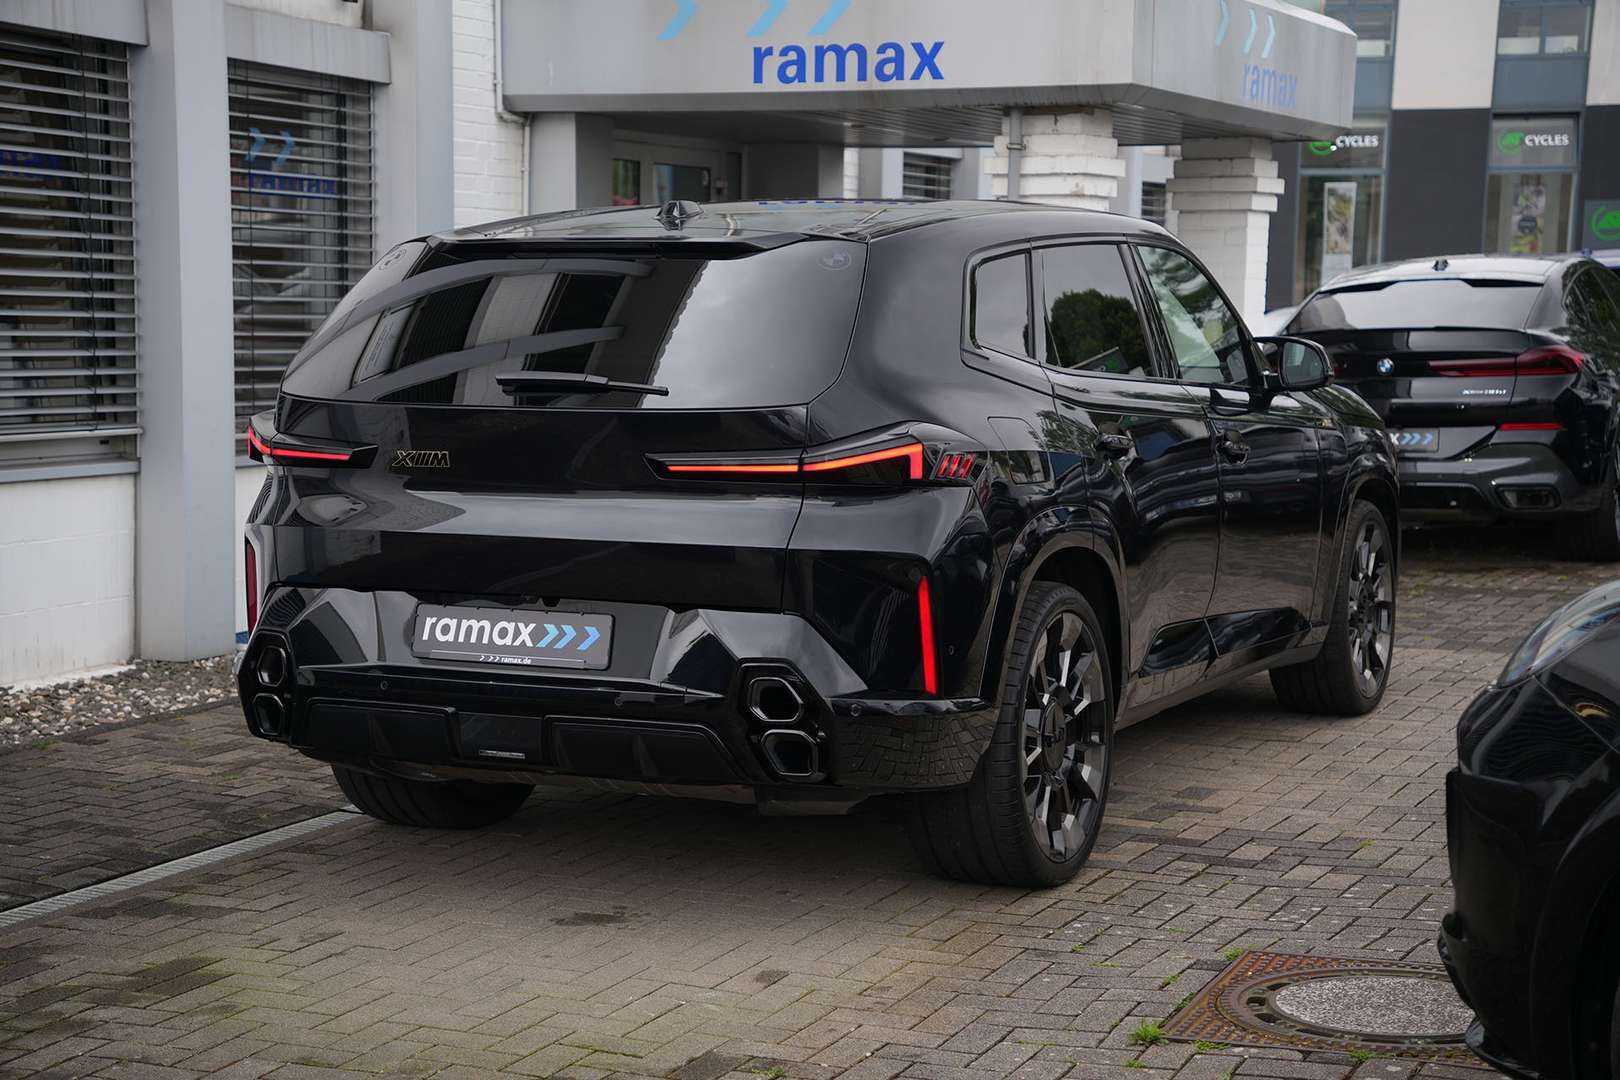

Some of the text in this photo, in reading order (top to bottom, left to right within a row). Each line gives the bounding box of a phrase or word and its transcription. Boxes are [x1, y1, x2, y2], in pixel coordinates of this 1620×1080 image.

[753, 41, 945, 84] ramax
[1242, 64, 1297, 107] ramax
[1336, 135, 1379, 148] CYCLES
[1525, 134, 1569, 147] CYCLES
[422, 616, 537, 648] ramax
[501, 656, 532, 665] ramax.de
